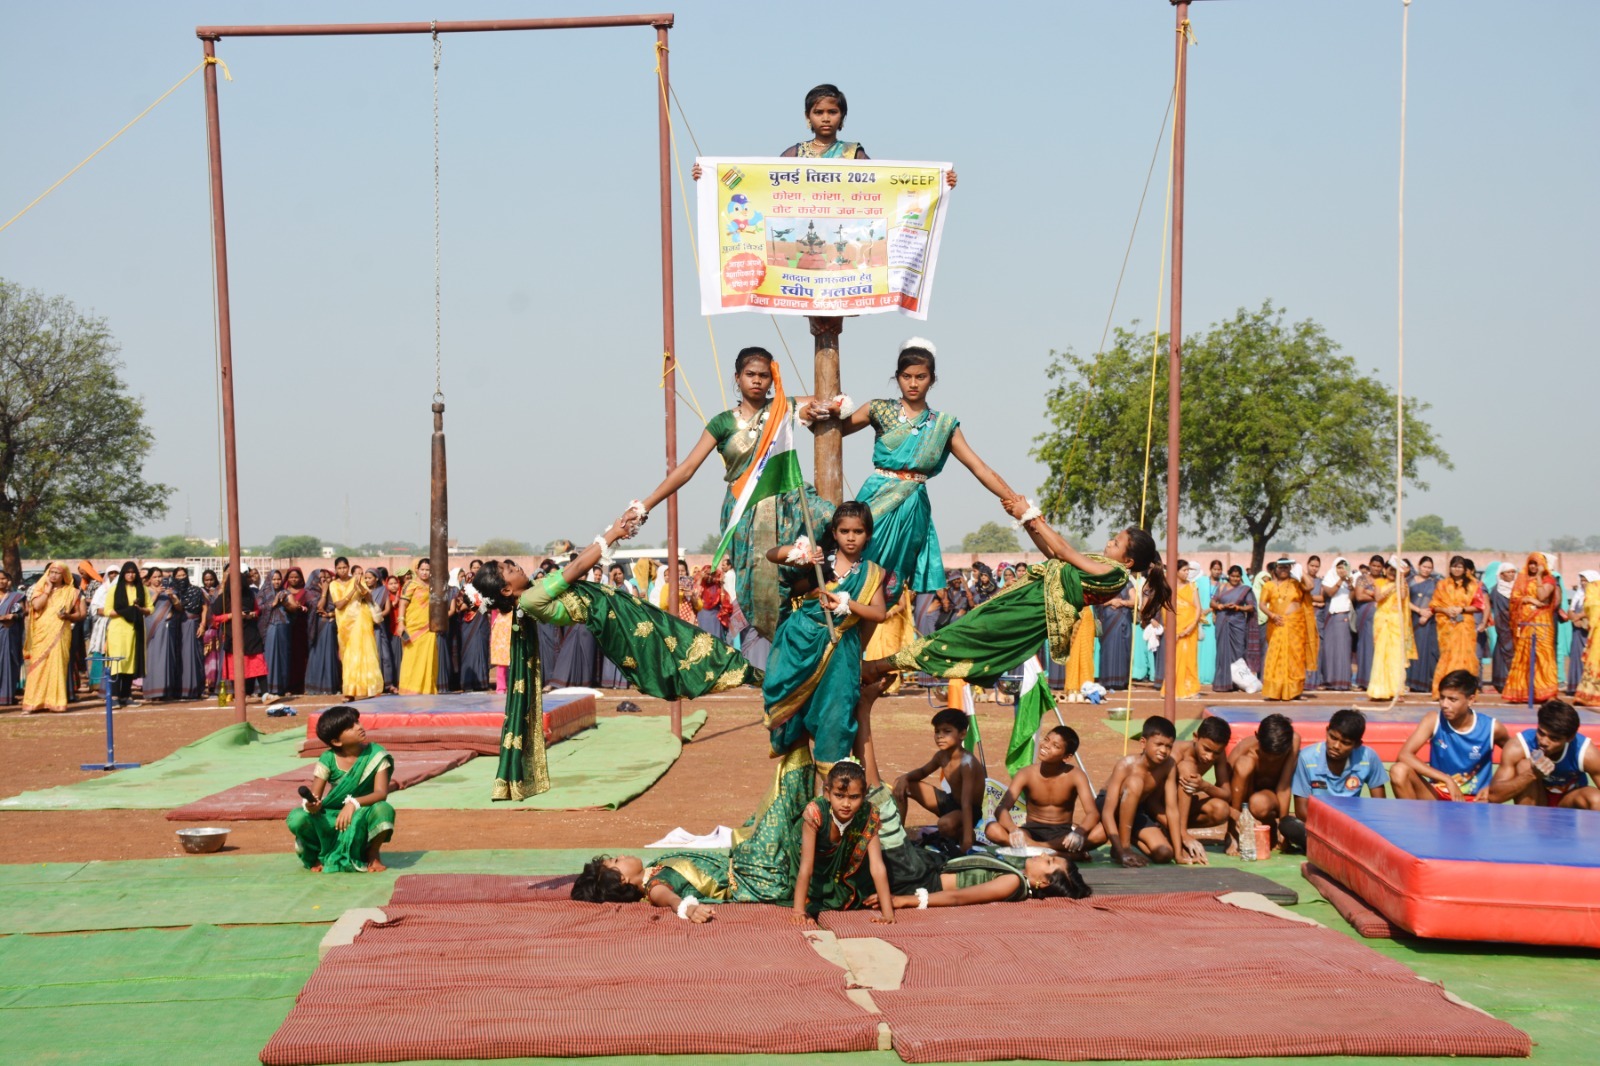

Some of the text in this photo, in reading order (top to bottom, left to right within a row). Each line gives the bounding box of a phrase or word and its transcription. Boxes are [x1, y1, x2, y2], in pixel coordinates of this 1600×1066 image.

[769, 168, 876, 186] चुनई तिहार 2024
[890, 173, 935, 185] SWEEP
[851, 191, 882, 201] कंचन
[772, 205, 884, 215] वोट करेगा जन-जन
[782, 273, 810, 284] मतदान
[860, 272, 872, 282] हेतु
[780, 284, 814, 297] स्वीप
[750, 294, 769, 305] जिला
[774, 298, 809, 309] प्रशासन
